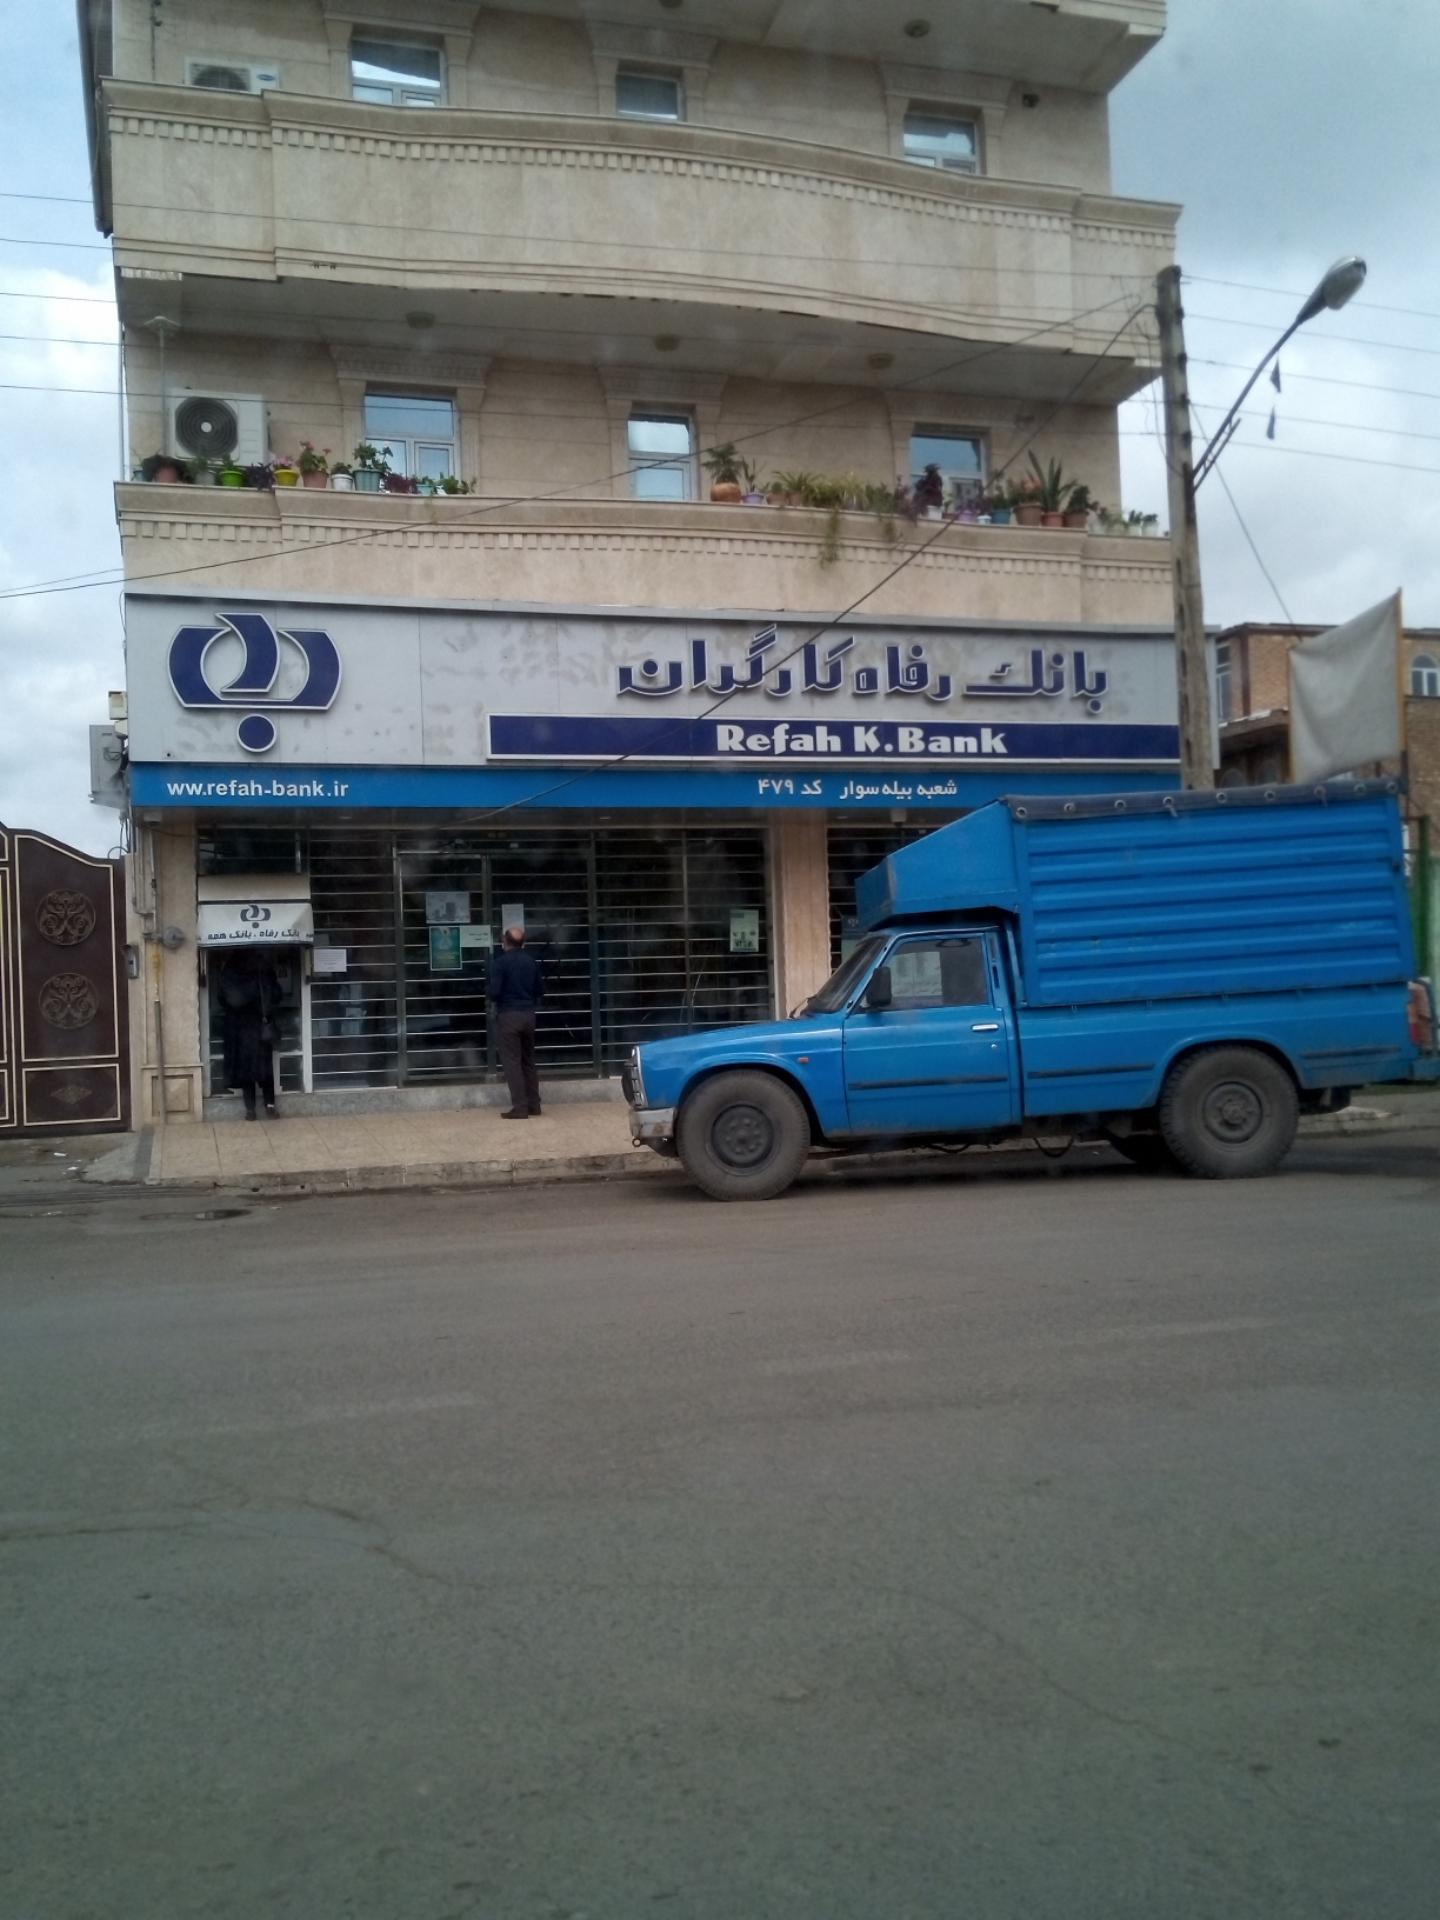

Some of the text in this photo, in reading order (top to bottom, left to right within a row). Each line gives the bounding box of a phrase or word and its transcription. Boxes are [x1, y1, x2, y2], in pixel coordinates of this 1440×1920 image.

[616, 623, 855, 697] کارگران
[854, 644, 953, 701] رفاه
[716, 723, 1009, 755] Refah K.Bank
[757, 779, 794, 795] ۴۷۹
[801, 779, 823, 795] کد
[916, 779, 958, 799] شعبه
